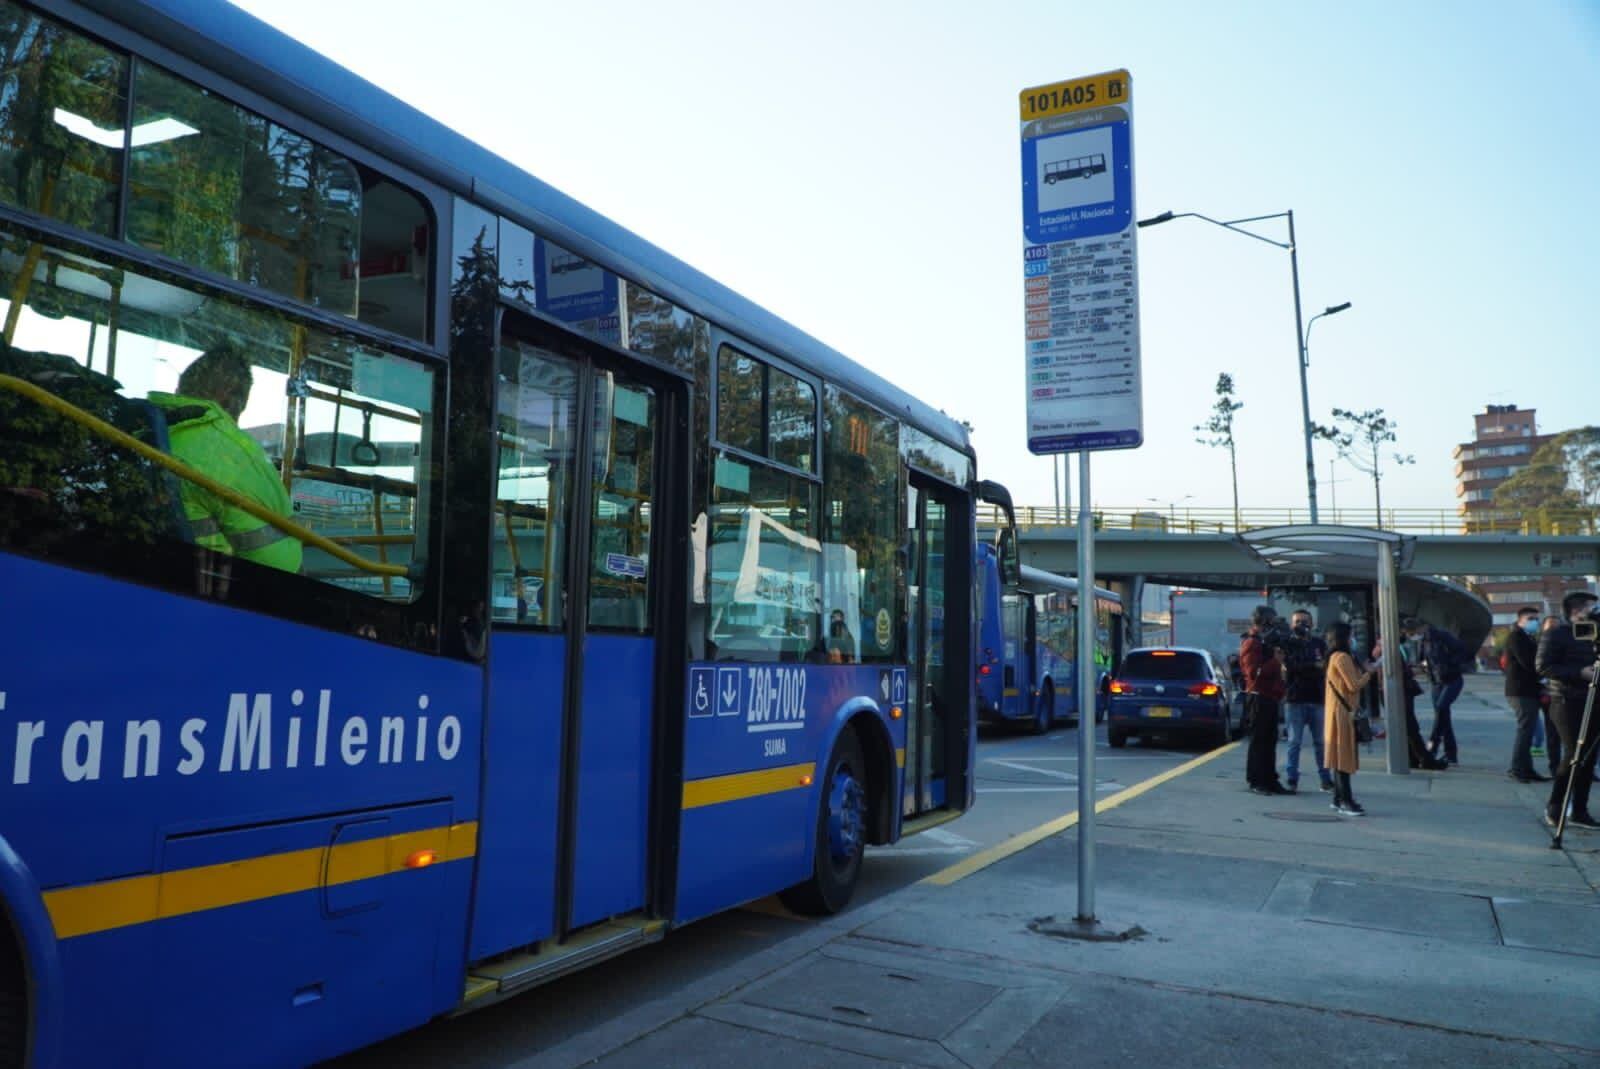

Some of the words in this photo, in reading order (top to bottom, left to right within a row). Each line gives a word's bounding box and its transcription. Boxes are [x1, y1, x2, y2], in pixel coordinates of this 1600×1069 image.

[1027, 83, 1096, 113] 101A05
[1080, 206, 1114, 220] Nacional
[1026, 247, 1047, 259] A103
[747, 667, 807, 723] Z80-7002
[0, 688, 462, 785] ransMilenio
[763, 738, 787, 757] SUMA
